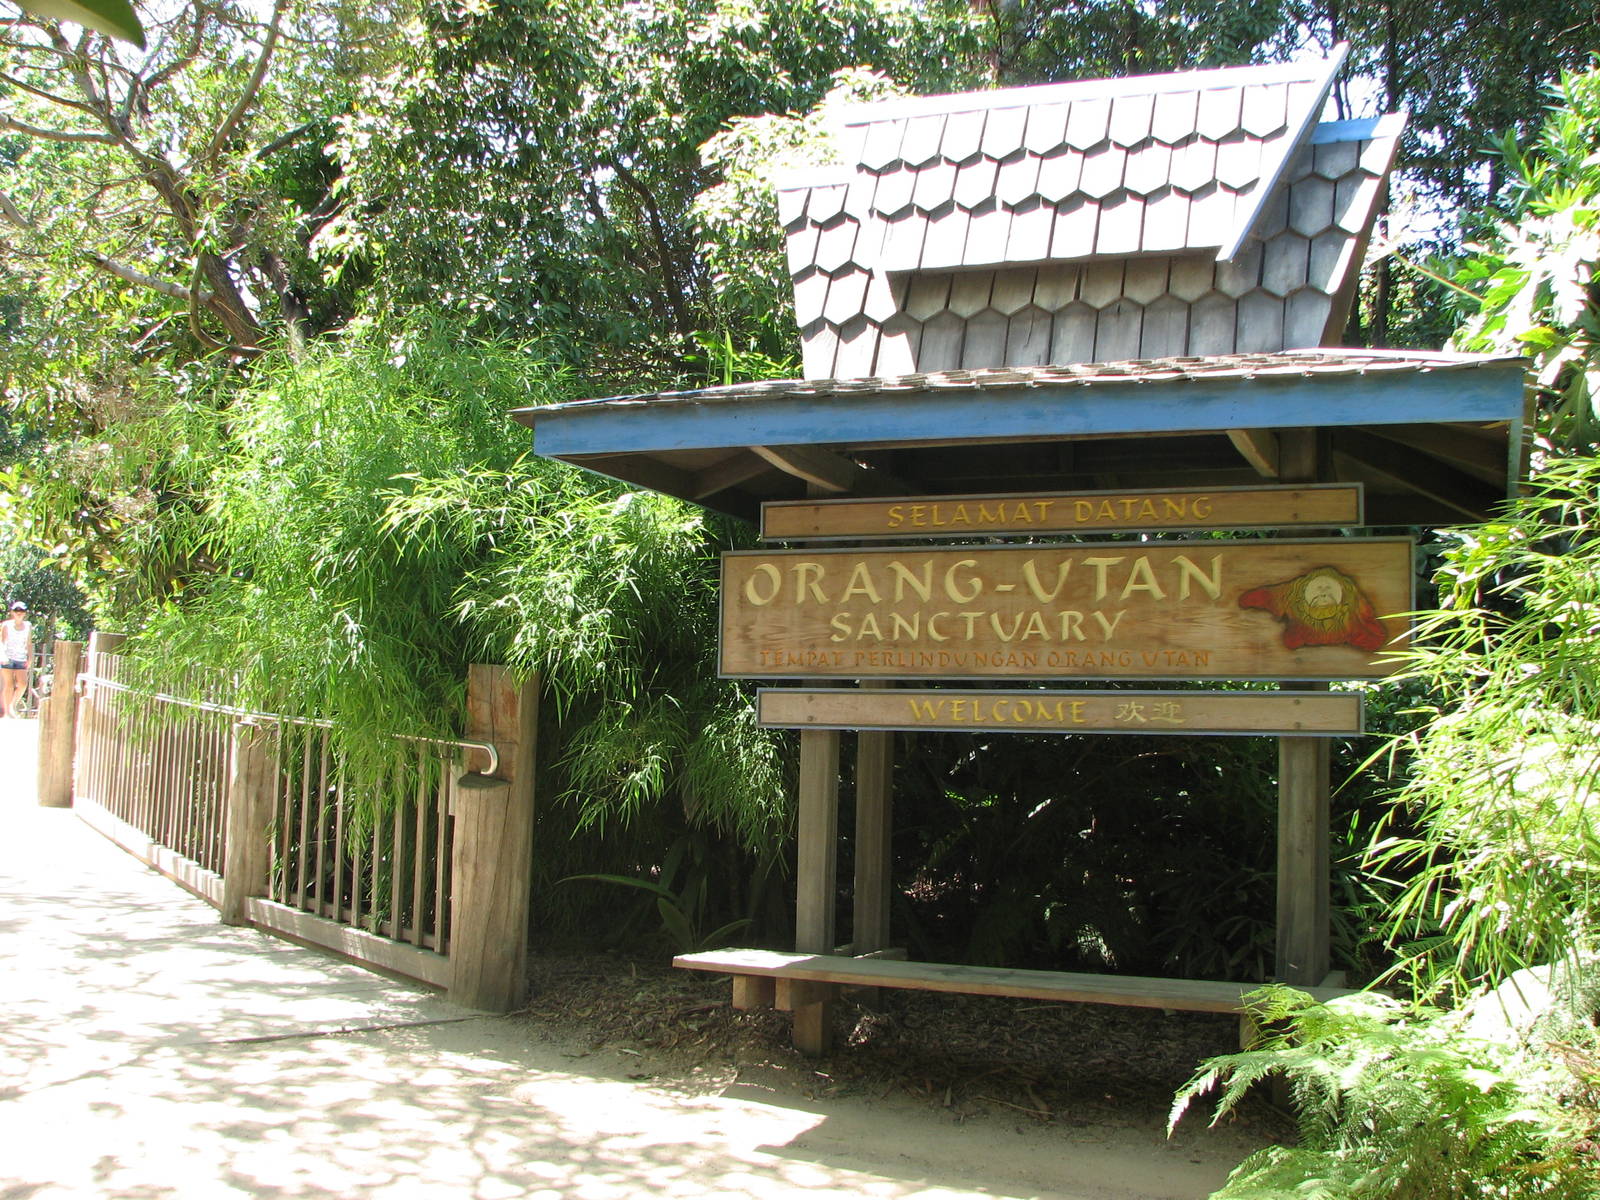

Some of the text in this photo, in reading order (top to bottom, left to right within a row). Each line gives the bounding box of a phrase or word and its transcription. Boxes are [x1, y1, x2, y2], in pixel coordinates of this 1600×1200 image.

[887, 497, 1213, 528] SELAMAT DATANG
[745, 553, 1223, 606] ORANG-UTAN
[830, 609, 1127, 642] SANCTUARY
[760, 650, 1212, 668] TEMPAT PERLINDUNGAN ORANG UTAN
[908, 699, 1088, 723] WELCOME
[1112, 701, 1187, 723] 欢迎
